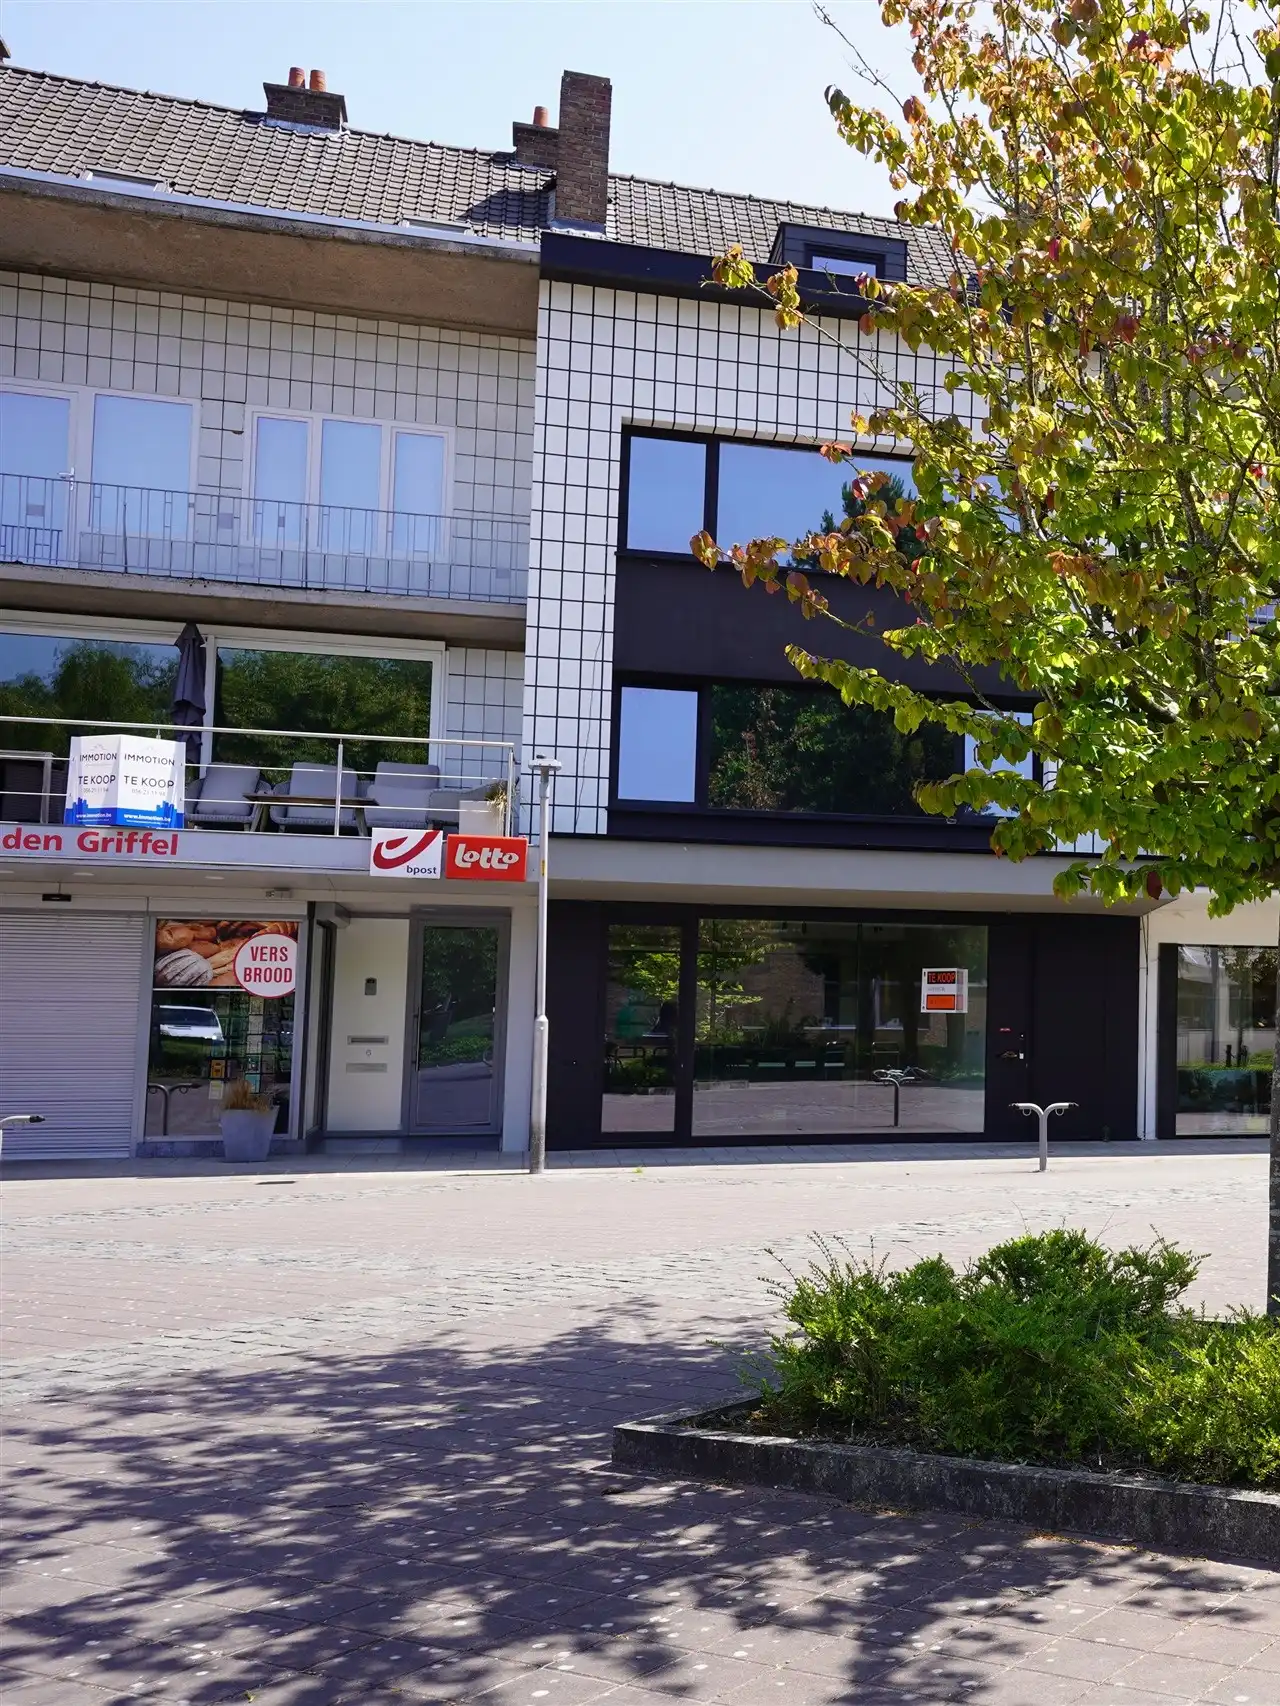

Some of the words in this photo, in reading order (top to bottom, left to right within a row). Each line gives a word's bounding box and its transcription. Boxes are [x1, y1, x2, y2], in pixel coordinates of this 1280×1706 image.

[79, 753, 117, 762] IMMOTION
[124, 753, 175, 766] IMMOTION
[78, 775, 88, 785] TE
[90, 774, 116, 785] KOOP
[123, 775, 138, 785] TE
[141, 777, 175, 788] KOOP
[123, 813, 171, 822] www.immotion.be
[2, 827, 62, 851] den
[77, 831, 179, 856] Griffel
[406, 865, 437, 875] bpost
[250, 946, 289, 962] VERS
[243, 967, 293, 983] BROOD
[937, 972, 955, 982] KOOP
